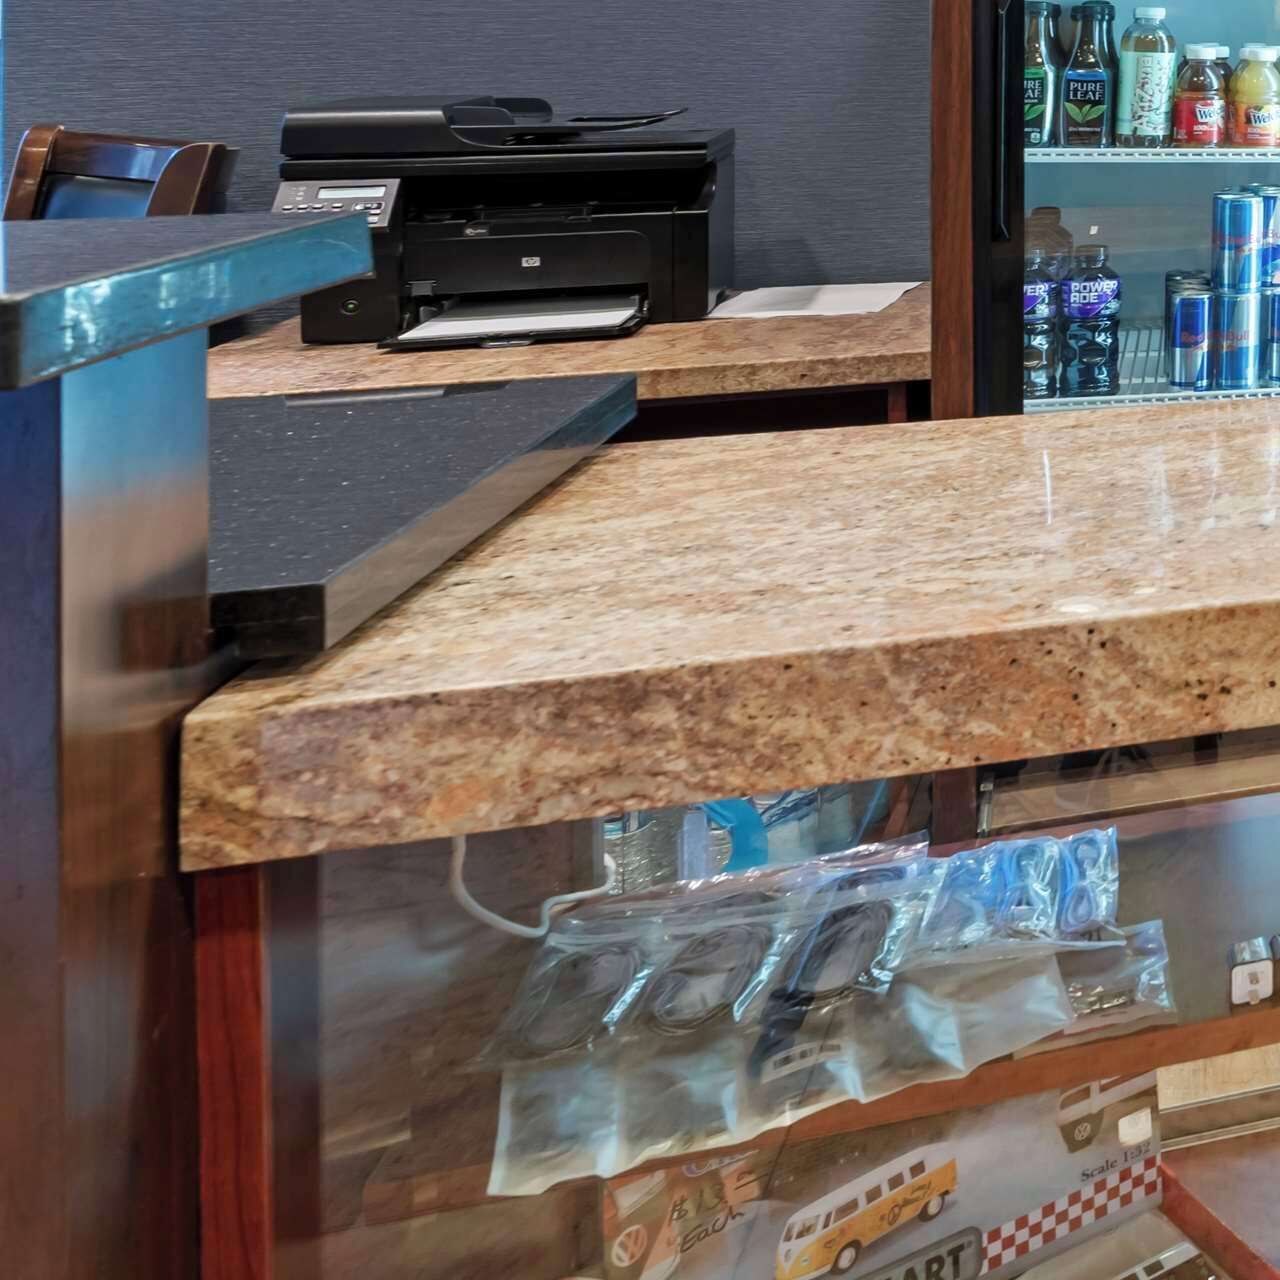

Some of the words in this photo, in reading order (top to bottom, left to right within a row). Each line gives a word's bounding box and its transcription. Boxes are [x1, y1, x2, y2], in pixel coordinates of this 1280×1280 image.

[1068, 80, 1104, 92] PURE
[1068, 89, 1103, 101] LEAF
[1071, 280, 1118, 294] POWER
[1070, 291, 1099, 304] ADE
[1079, 1159, 1118, 1183] Scale
[679, 1204, 745, 1254] Each
